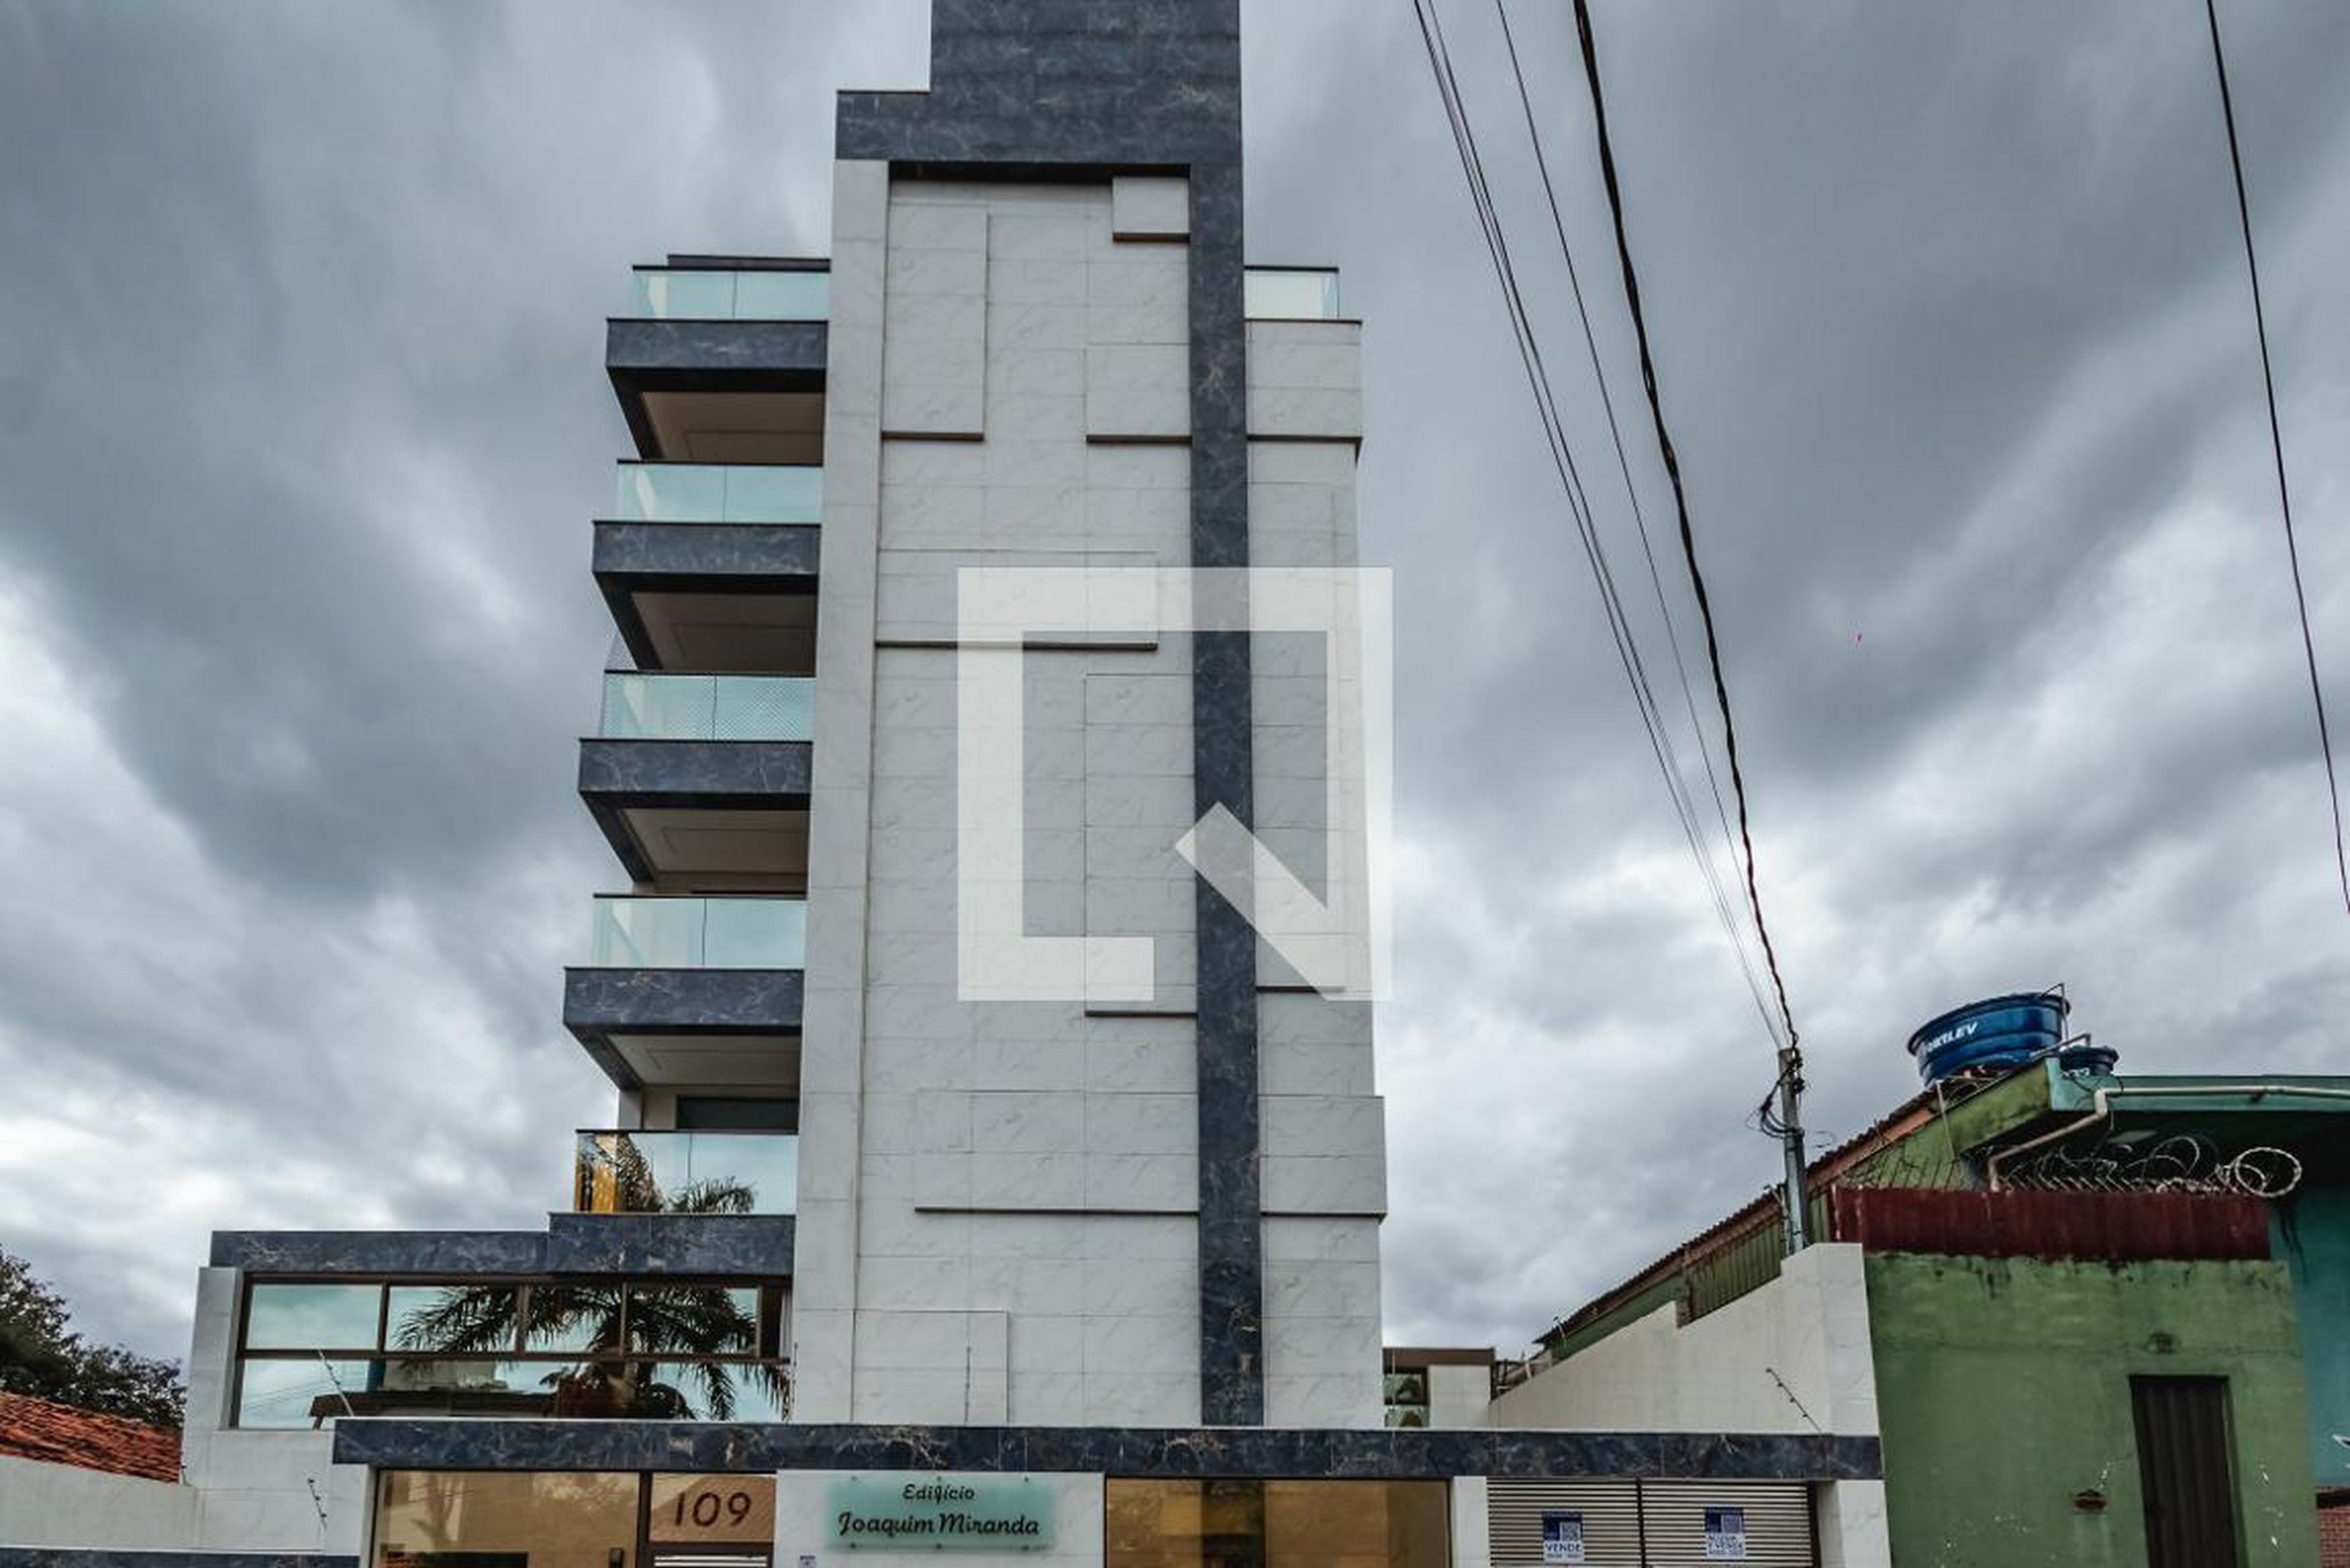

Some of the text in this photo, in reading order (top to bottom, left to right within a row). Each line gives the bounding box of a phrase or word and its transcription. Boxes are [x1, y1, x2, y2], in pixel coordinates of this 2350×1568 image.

[901, 1483, 975, 1504] Edifício
[675, 1491, 752, 1527] 109
[838, 1510, 1039, 1537] Joaquim Miranda
